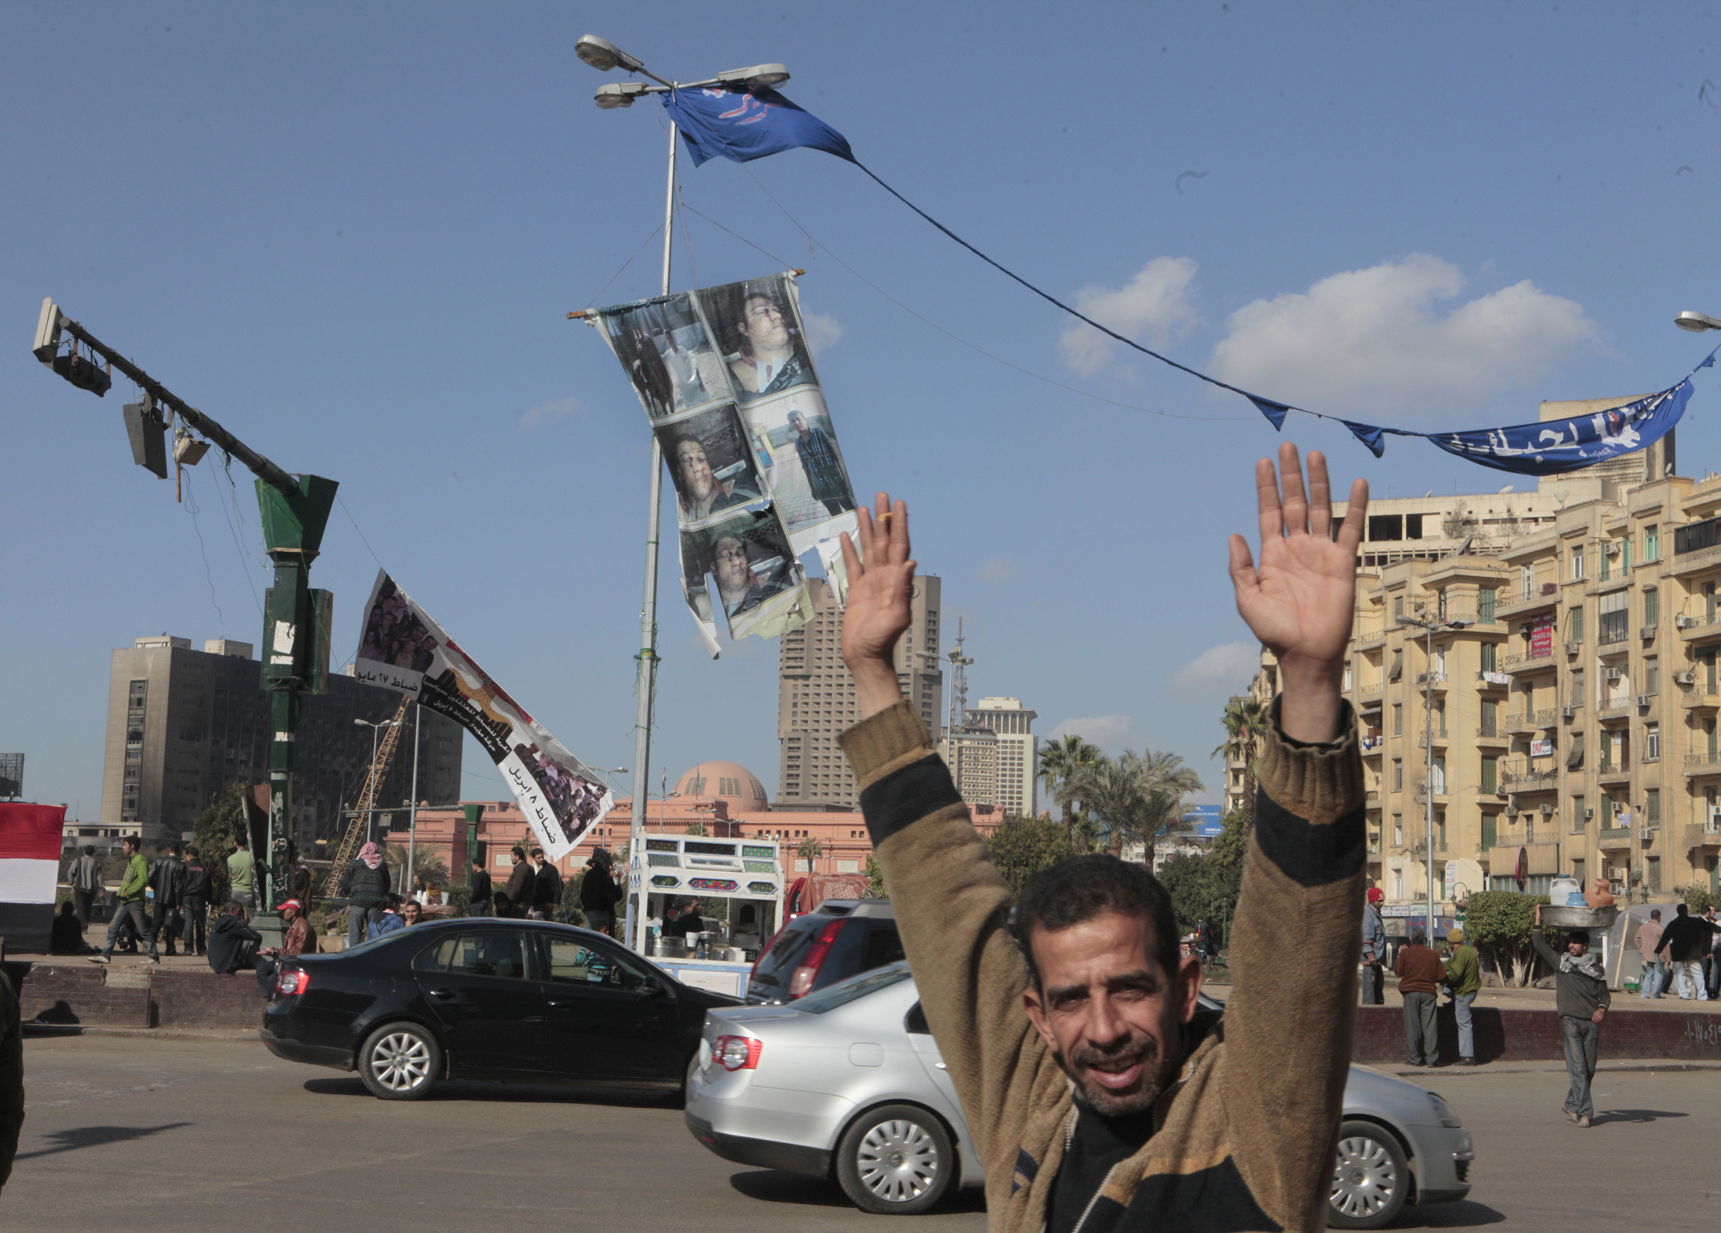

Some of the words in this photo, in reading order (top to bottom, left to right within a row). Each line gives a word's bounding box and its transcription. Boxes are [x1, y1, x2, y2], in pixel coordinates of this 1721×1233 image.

[390, 676, 418, 693] ضباط
[529, 795, 538, 805] ٨
[534, 806, 557, 846] ضباط
